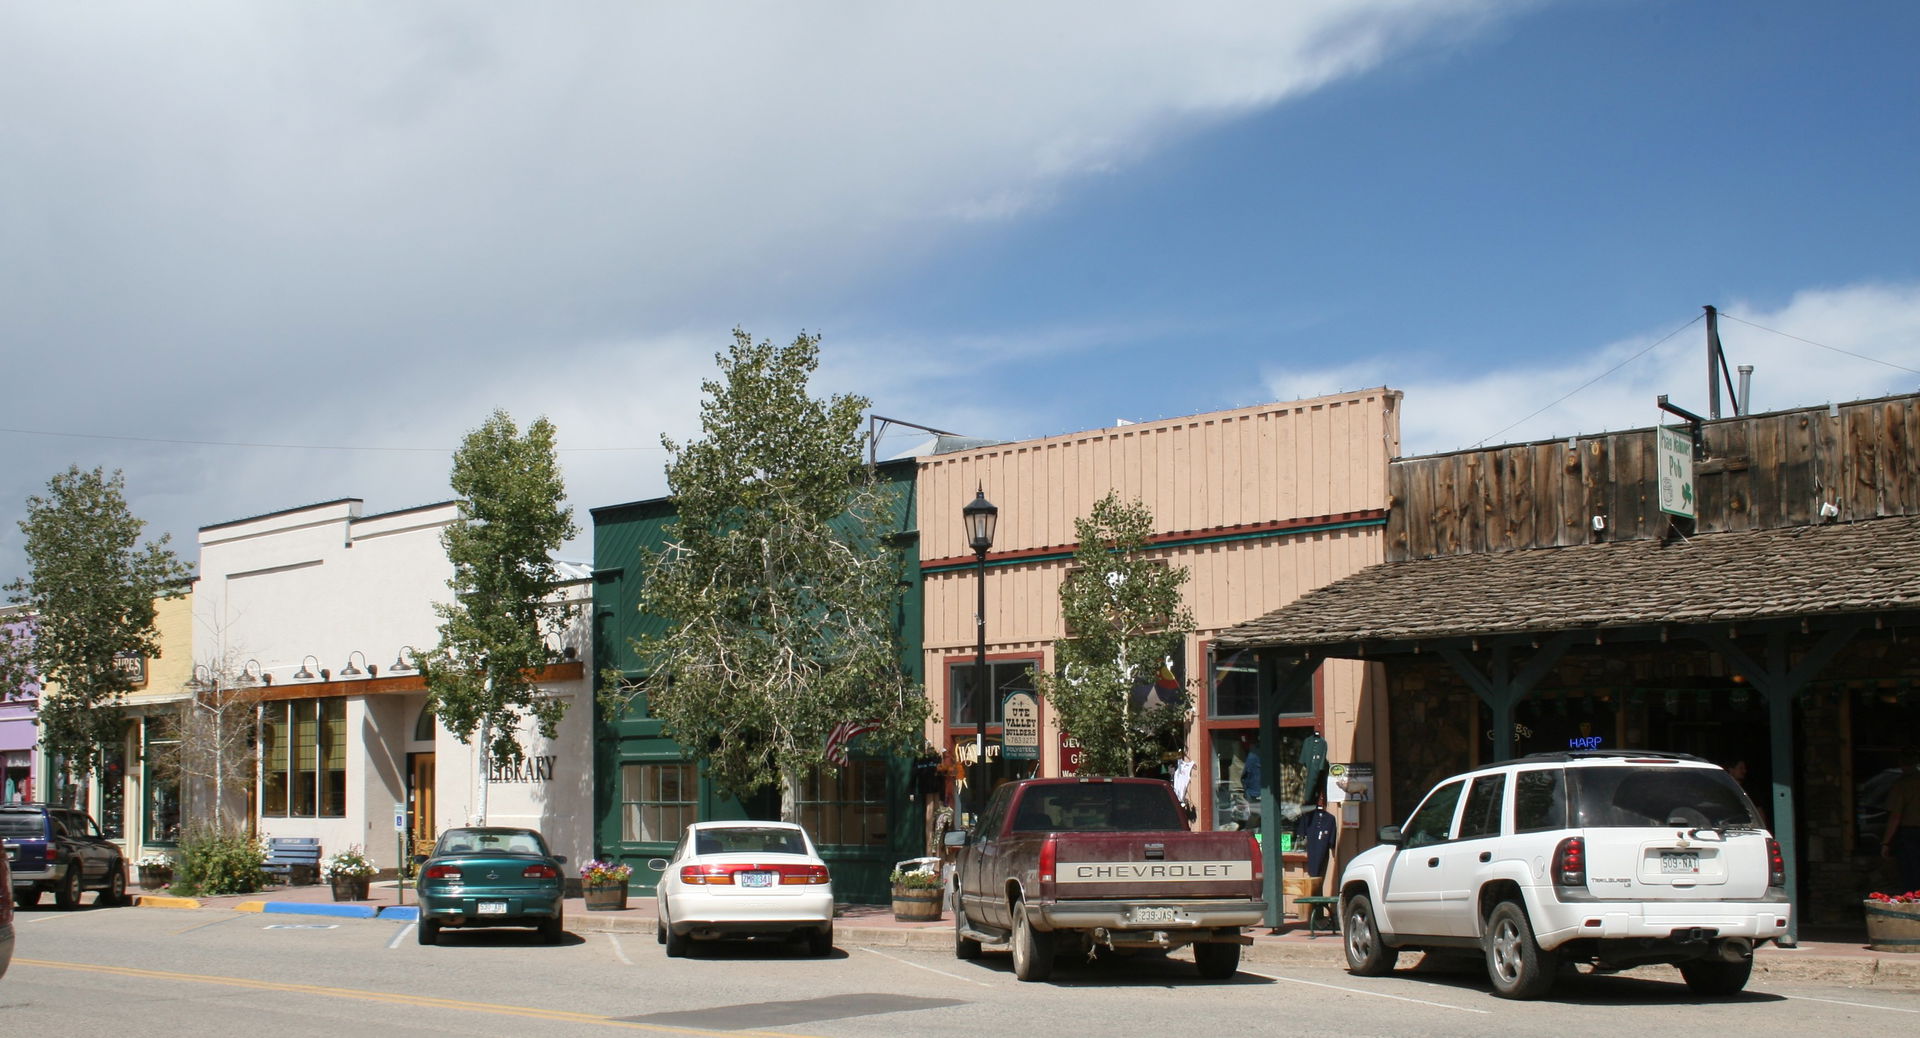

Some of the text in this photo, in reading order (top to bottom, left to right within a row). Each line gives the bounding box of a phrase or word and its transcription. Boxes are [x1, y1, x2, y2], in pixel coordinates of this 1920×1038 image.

[1012, 708, 1031, 717] UTE
[1005, 718, 1036, 728] VALLEY
[1006, 728, 1036, 737] BUILDERS
[1569, 736, 1602, 749] HARP
[488, 756, 557, 782] LIBRARY
[1077, 864, 1233, 878] CHEVROLET
